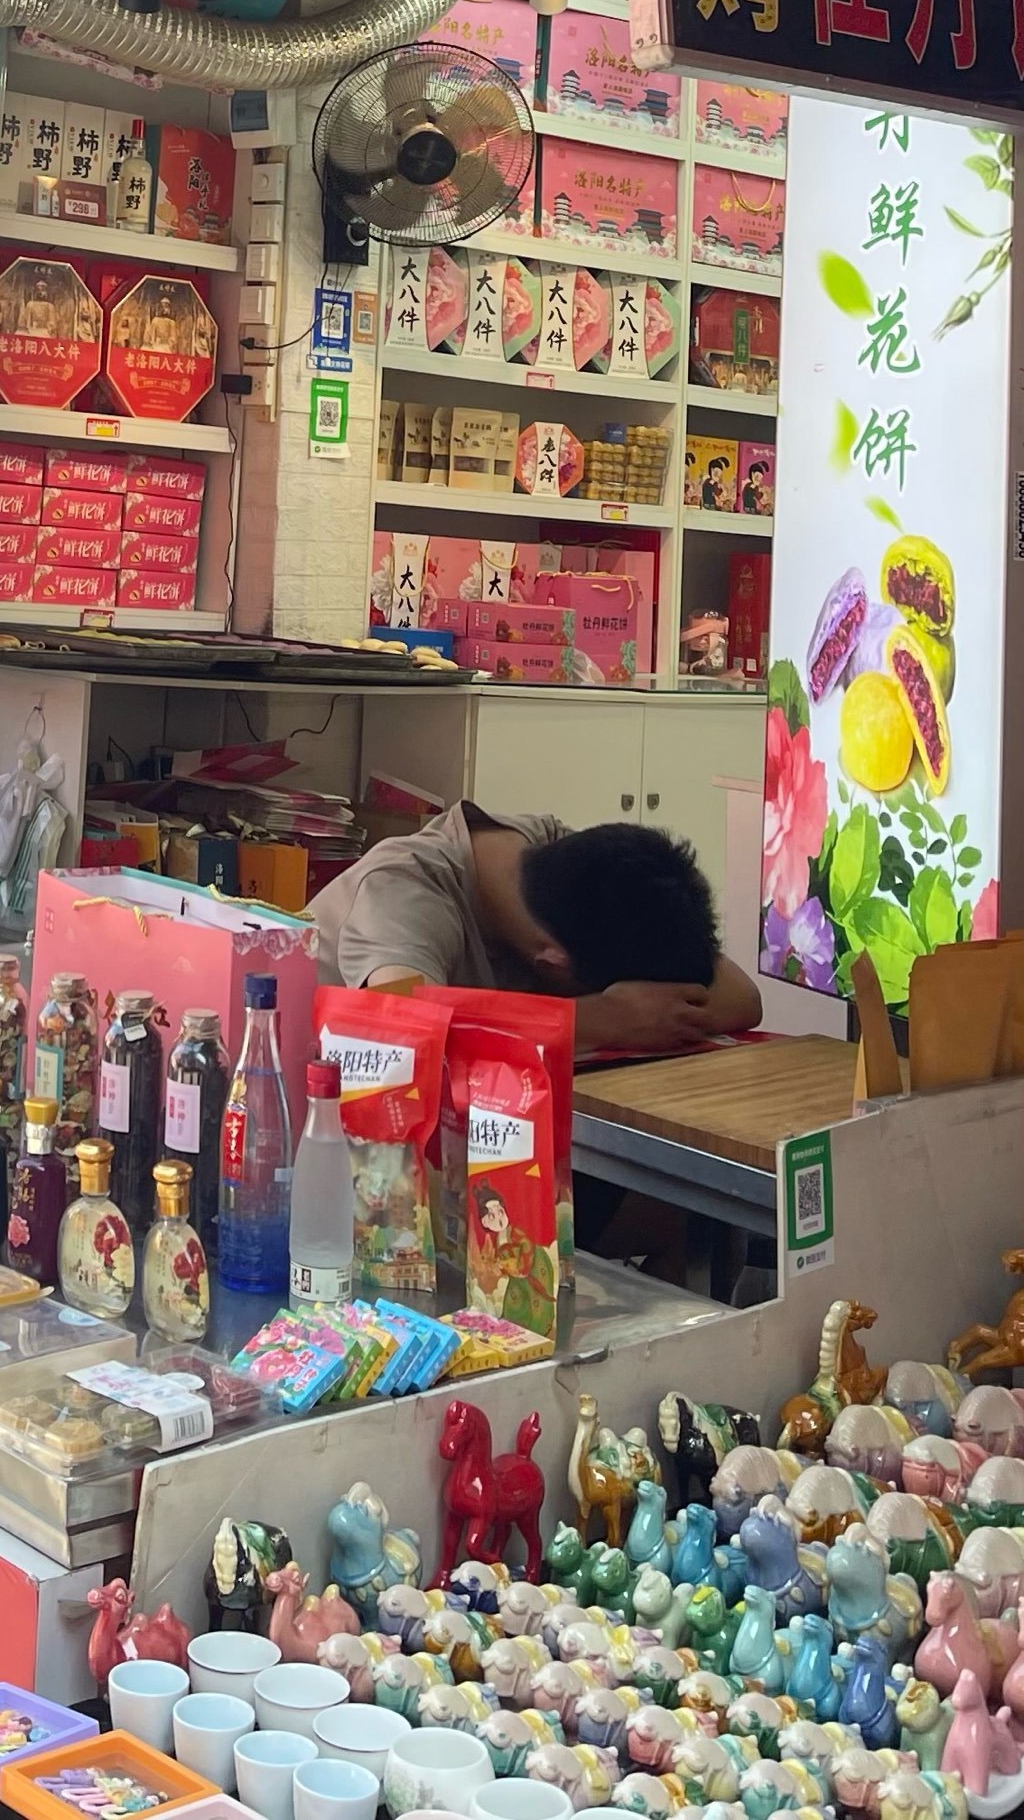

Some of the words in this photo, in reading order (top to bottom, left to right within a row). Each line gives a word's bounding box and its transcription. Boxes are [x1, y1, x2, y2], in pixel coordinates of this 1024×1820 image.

[32, 119, 61, 171] 柿野
[71, 127, 100, 179] 柿野
[125, 176, 147, 211] 柿野
[397, 255, 422, 335] 大八件
[473, 268, 498, 344] 大八件
[546, 279, 569, 354] 大八件
[618, 289, 641, 362] 大八件
